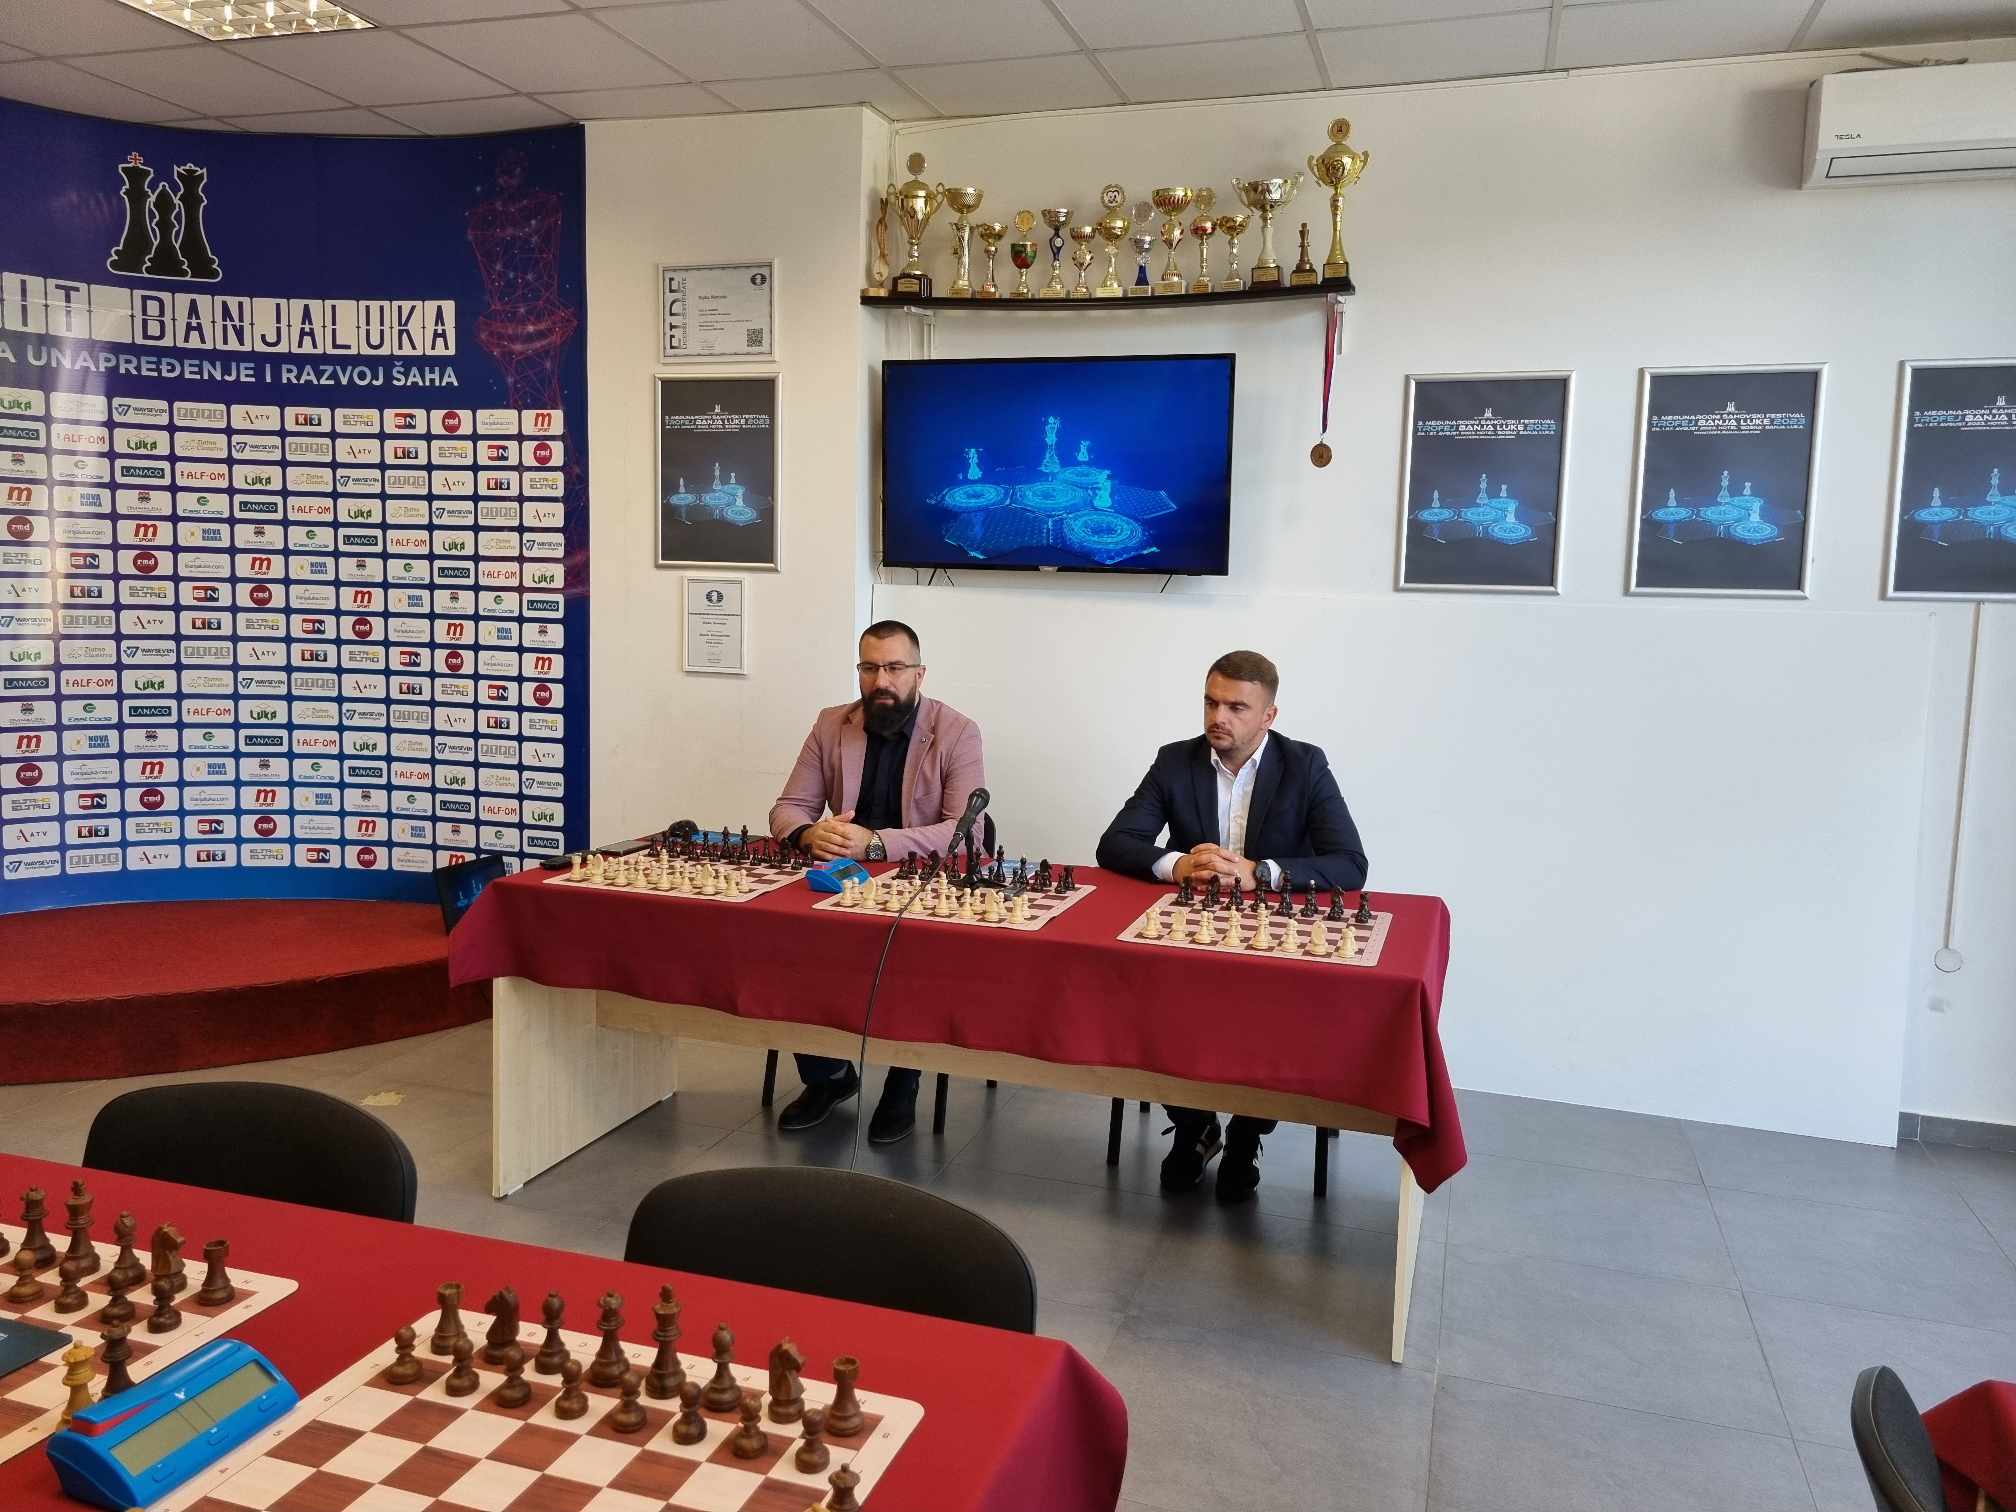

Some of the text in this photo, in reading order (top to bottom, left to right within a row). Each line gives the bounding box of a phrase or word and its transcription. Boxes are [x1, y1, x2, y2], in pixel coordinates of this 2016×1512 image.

[141, 294, 449, 351] BANJALUKA
[27, 344, 255, 383] UNAPREĐENJE
[265, 363, 272, 383] I
[281, 364, 384, 386] RAZVOJ
[392, 361, 459, 387] ŠAHA
[295, 414, 321, 426] K3
[1774, 417, 1806, 425] 2023
[63, 432, 105, 445] ALF-OM
[394, 447, 418, 459] K3
[123, 468, 163, 478] LANACO
[187, 471, 225, 481] ALF-OM
[487, 478, 510, 490] K3
[241, 503, 276, 511] LANACO
[297, 505, 331, 515] ALF-OM
[344, 537, 376, 545] LANACO
[396, 538, 427, 547] ALF-OM
[439, 569, 469, 577] LANACO
[486, 570, 518, 579] ALF-OM
[70, 586, 102, 598] K3
[528, 601, 559, 610] LANACO
[192, 618, 221, 630] K3
[301, 650, 327, 662] K3
[6, 680, 47, 688] LANACO
[72, 679, 113, 688] ALF-OM
[400, 683, 422, 695] K3
[193, 707, 231, 716] ALF-OM
[487, 717, 510, 729] K3
[88, 735, 109, 743] NOVA
[302, 738, 336, 747] ALF-OM
[399, 771, 430, 780] ALF-OM
[441, 802, 470, 811] LANACO
[487, 806, 517, 816] ALF-OM
[78, 825, 109, 838] K3
[529, 838, 559, 848] LANACO
[197, 850, 225, 862] K3
